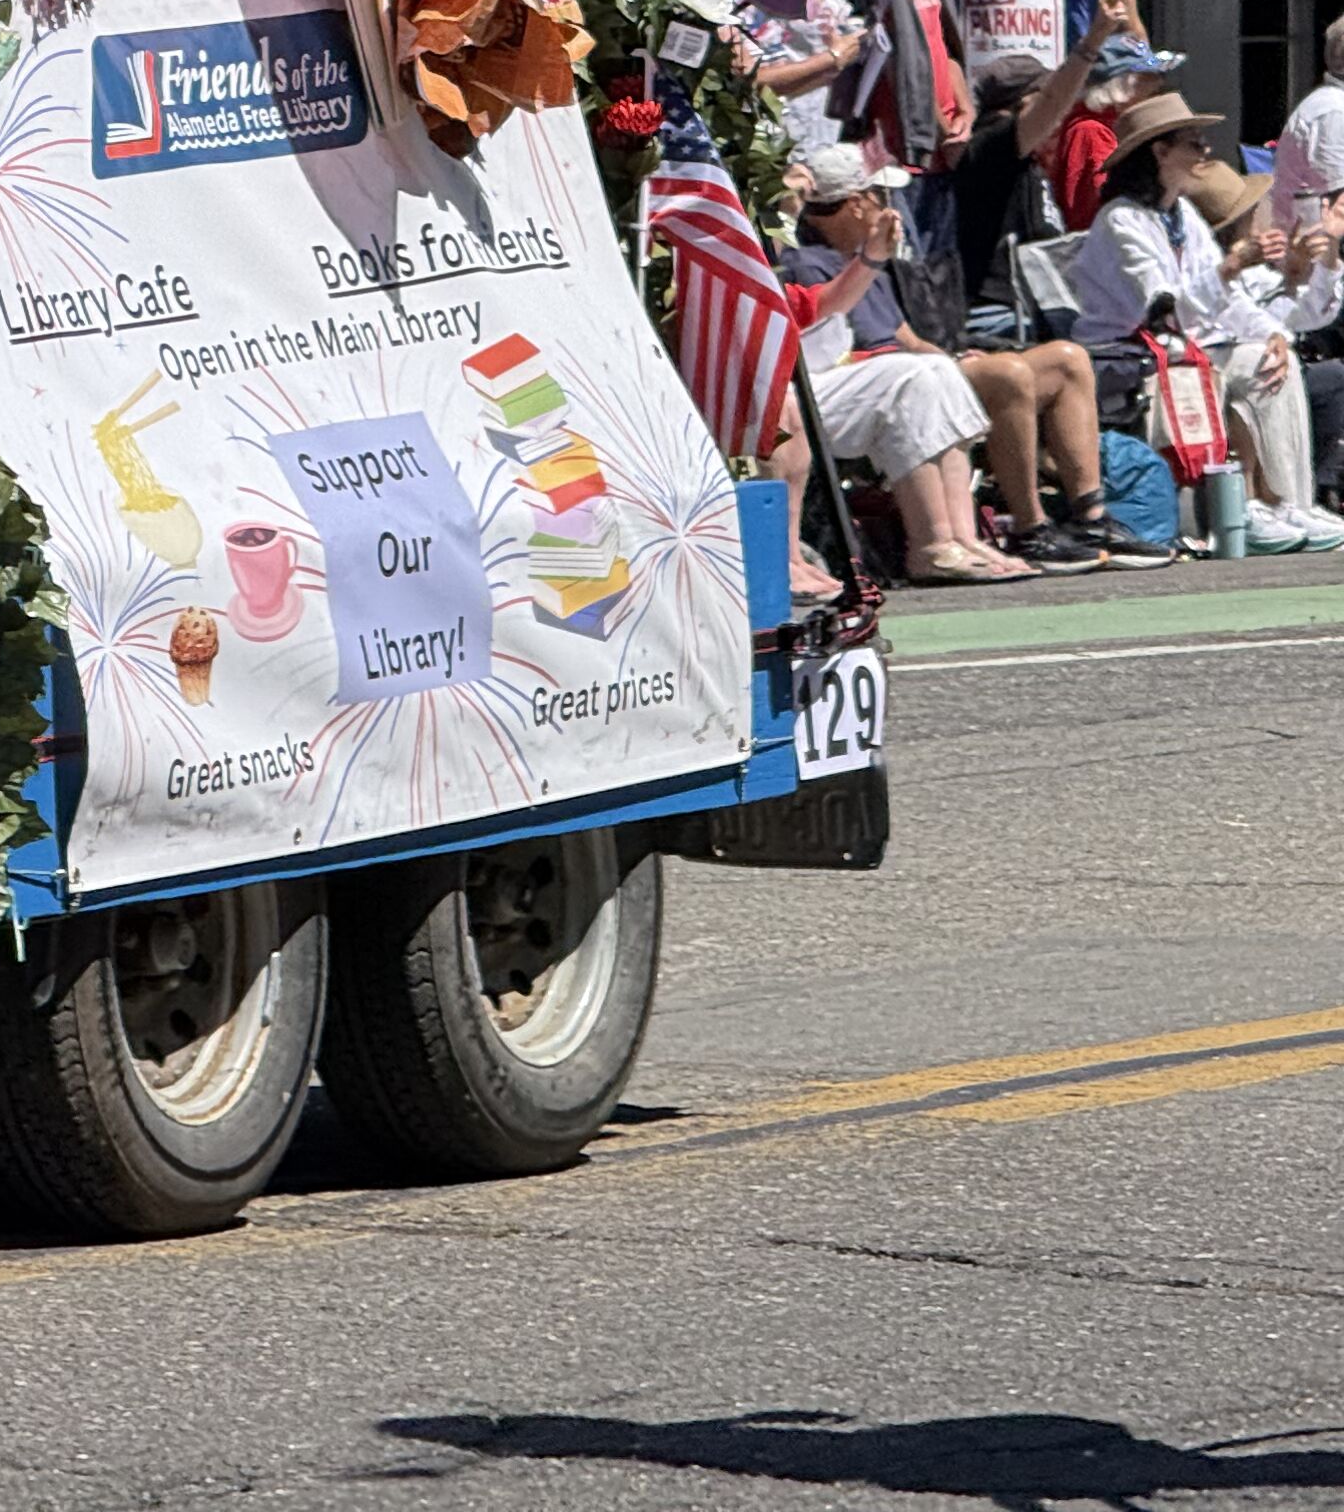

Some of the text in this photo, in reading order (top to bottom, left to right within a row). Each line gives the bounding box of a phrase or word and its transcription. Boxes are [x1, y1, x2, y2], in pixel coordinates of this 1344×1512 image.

[969, 8, 1051, 37] PARKING
[159, 37, 348, 106] Friends of the
[166, 94, 352, 137] Alameda Free Library
[312, 233, 415, 289] Books
[419, 222, 478, 272] for
[115, 265, 194, 319] Cafe
[159, 301, 481, 390] Open in the Main Library
[298, 440, 428, 500] Support
[377, 532, 432, 577] Our
[359, 616, 465, 679] Library!
[533, 667, 675, 727] Great prices
[798, 665, 878, 764] 129
[167, 732, 315, 800] Great snacks
